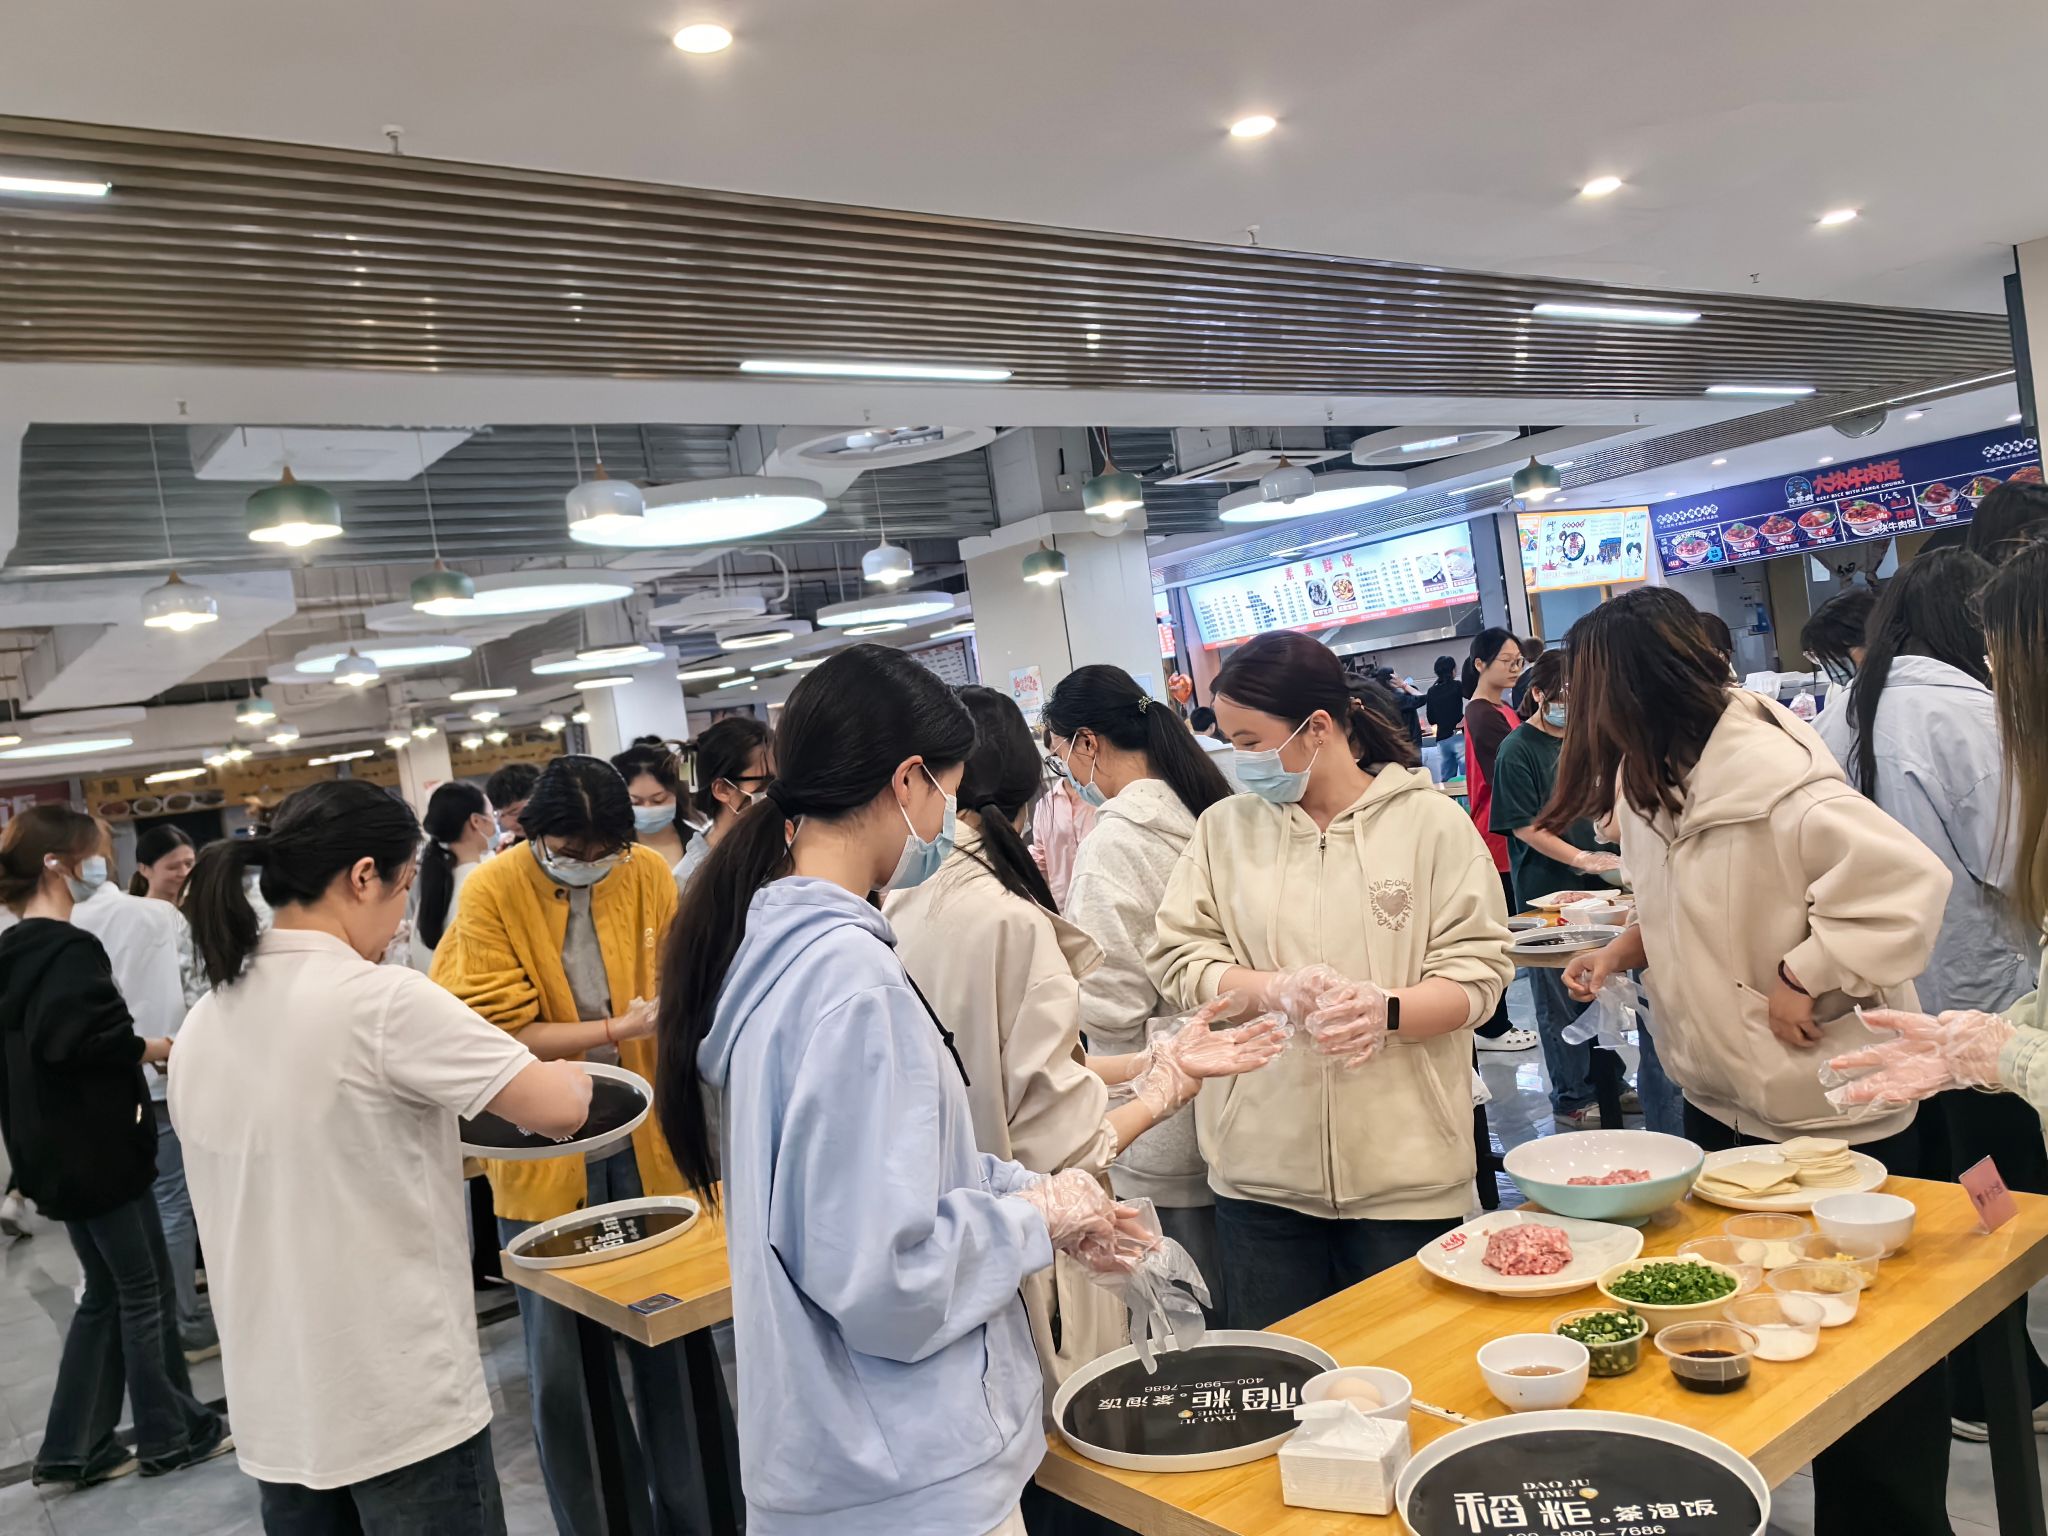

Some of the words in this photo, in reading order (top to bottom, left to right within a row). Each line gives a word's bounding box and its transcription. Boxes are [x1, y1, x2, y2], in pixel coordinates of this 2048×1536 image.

[1881, 480, 1905, 488] CHUNKS
[1180, 1417, 1199, 1425] JU
[1203, 1414, 1237, 1423] DAO
[1522, 1480, 1563, 1490] DAO
[1568, 1478, 1590, 1488] JU
[1523, 1489, 1575, 1499] TIME
